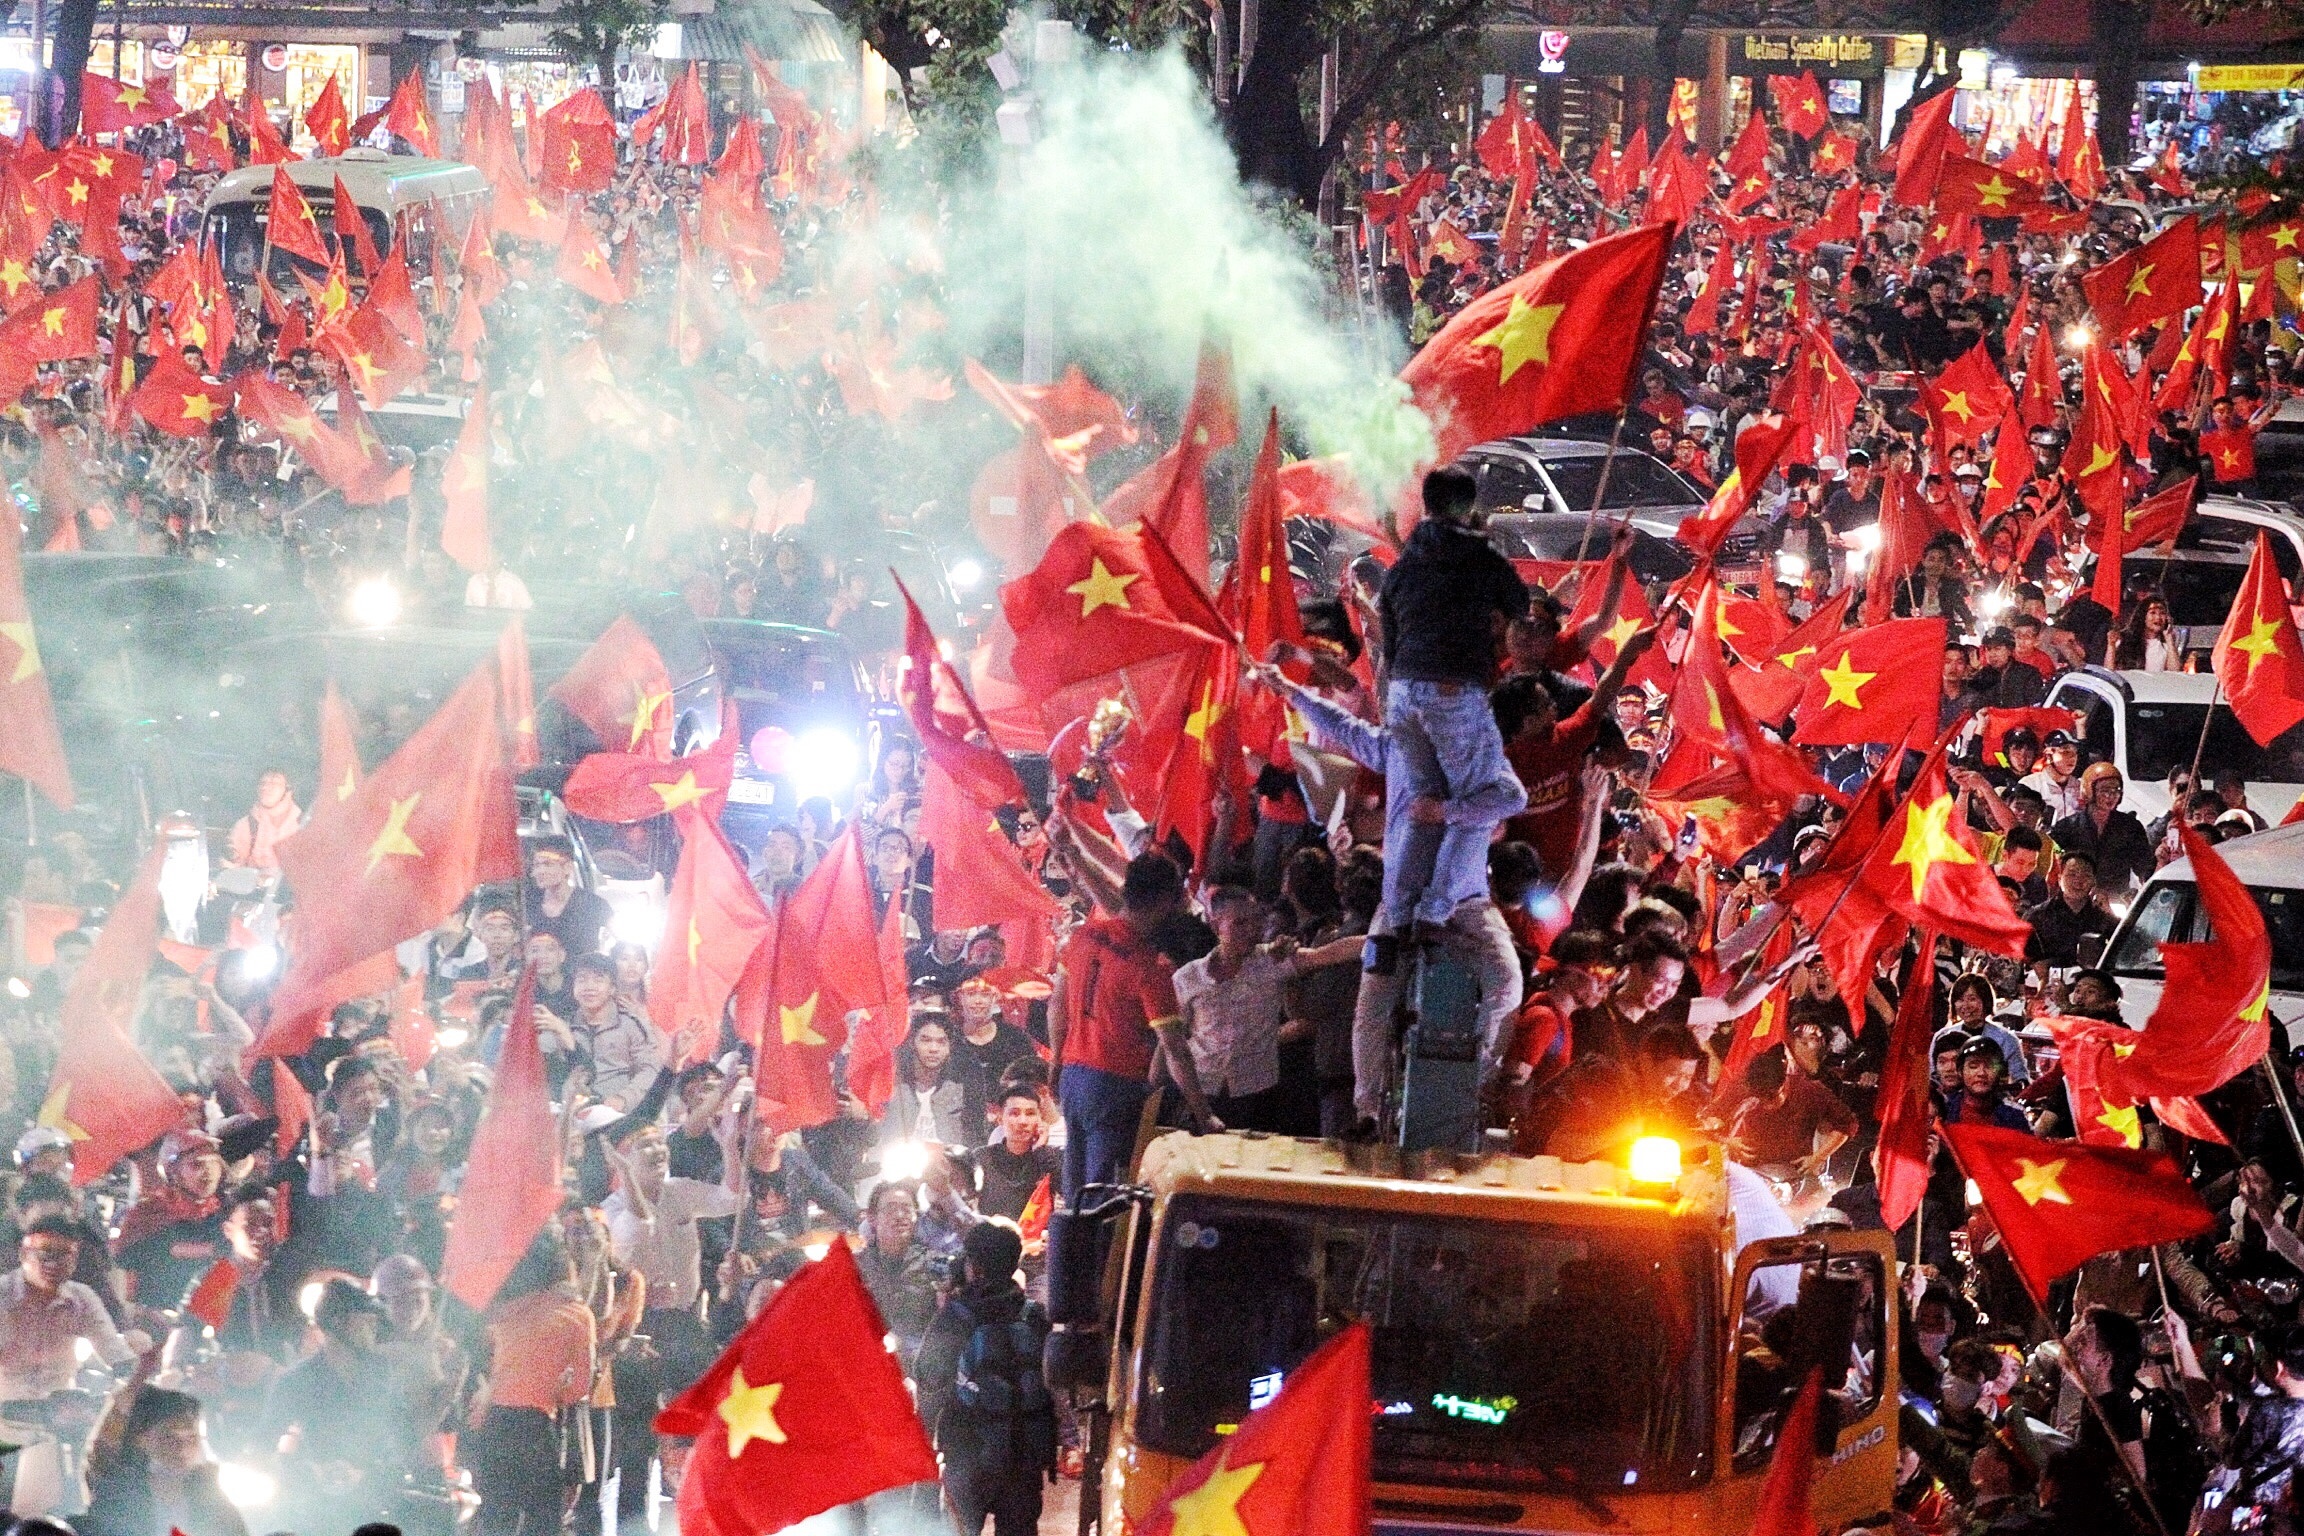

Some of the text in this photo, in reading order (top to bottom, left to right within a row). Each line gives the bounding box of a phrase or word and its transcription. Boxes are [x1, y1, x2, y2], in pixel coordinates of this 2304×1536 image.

[1745, 35, 1873, 68] Vietnam Specialty Coffee
[1831, 1425, 1885, 1465] HINO
